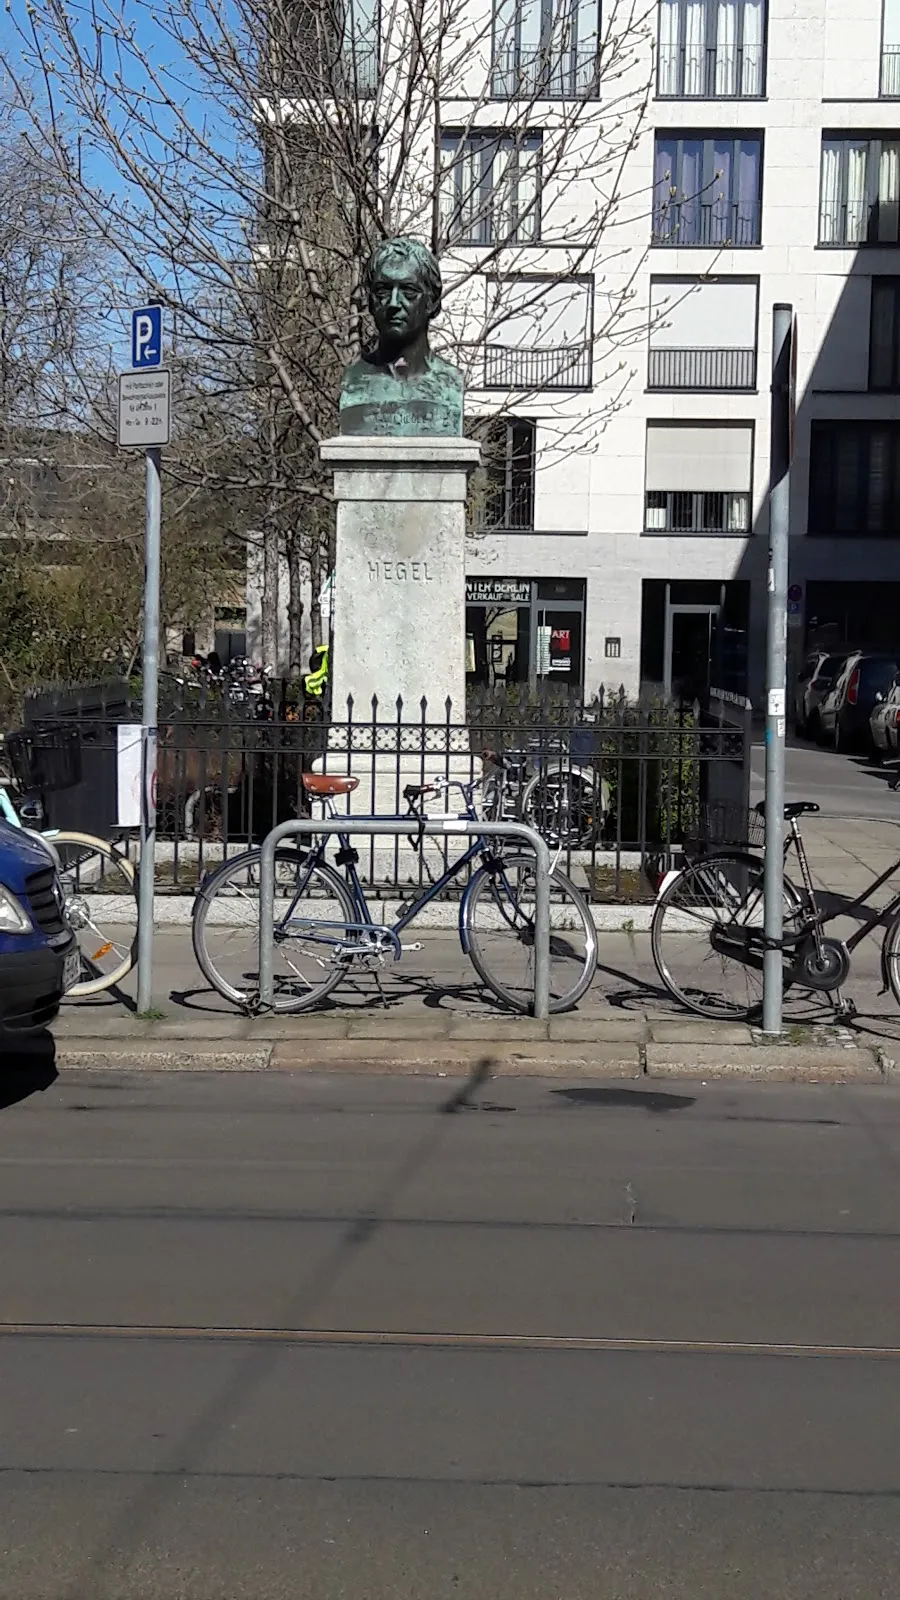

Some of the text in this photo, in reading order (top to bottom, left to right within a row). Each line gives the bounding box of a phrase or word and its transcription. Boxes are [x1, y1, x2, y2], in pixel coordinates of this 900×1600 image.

[136, 315, 153, 361] P
[367, 561, 433, 581] HEGEL
[494, 583, 530, 593] BERLIN
[467, 592, 530, 601] VERKAUF SALE
[551, 630, 571, 639] ART
